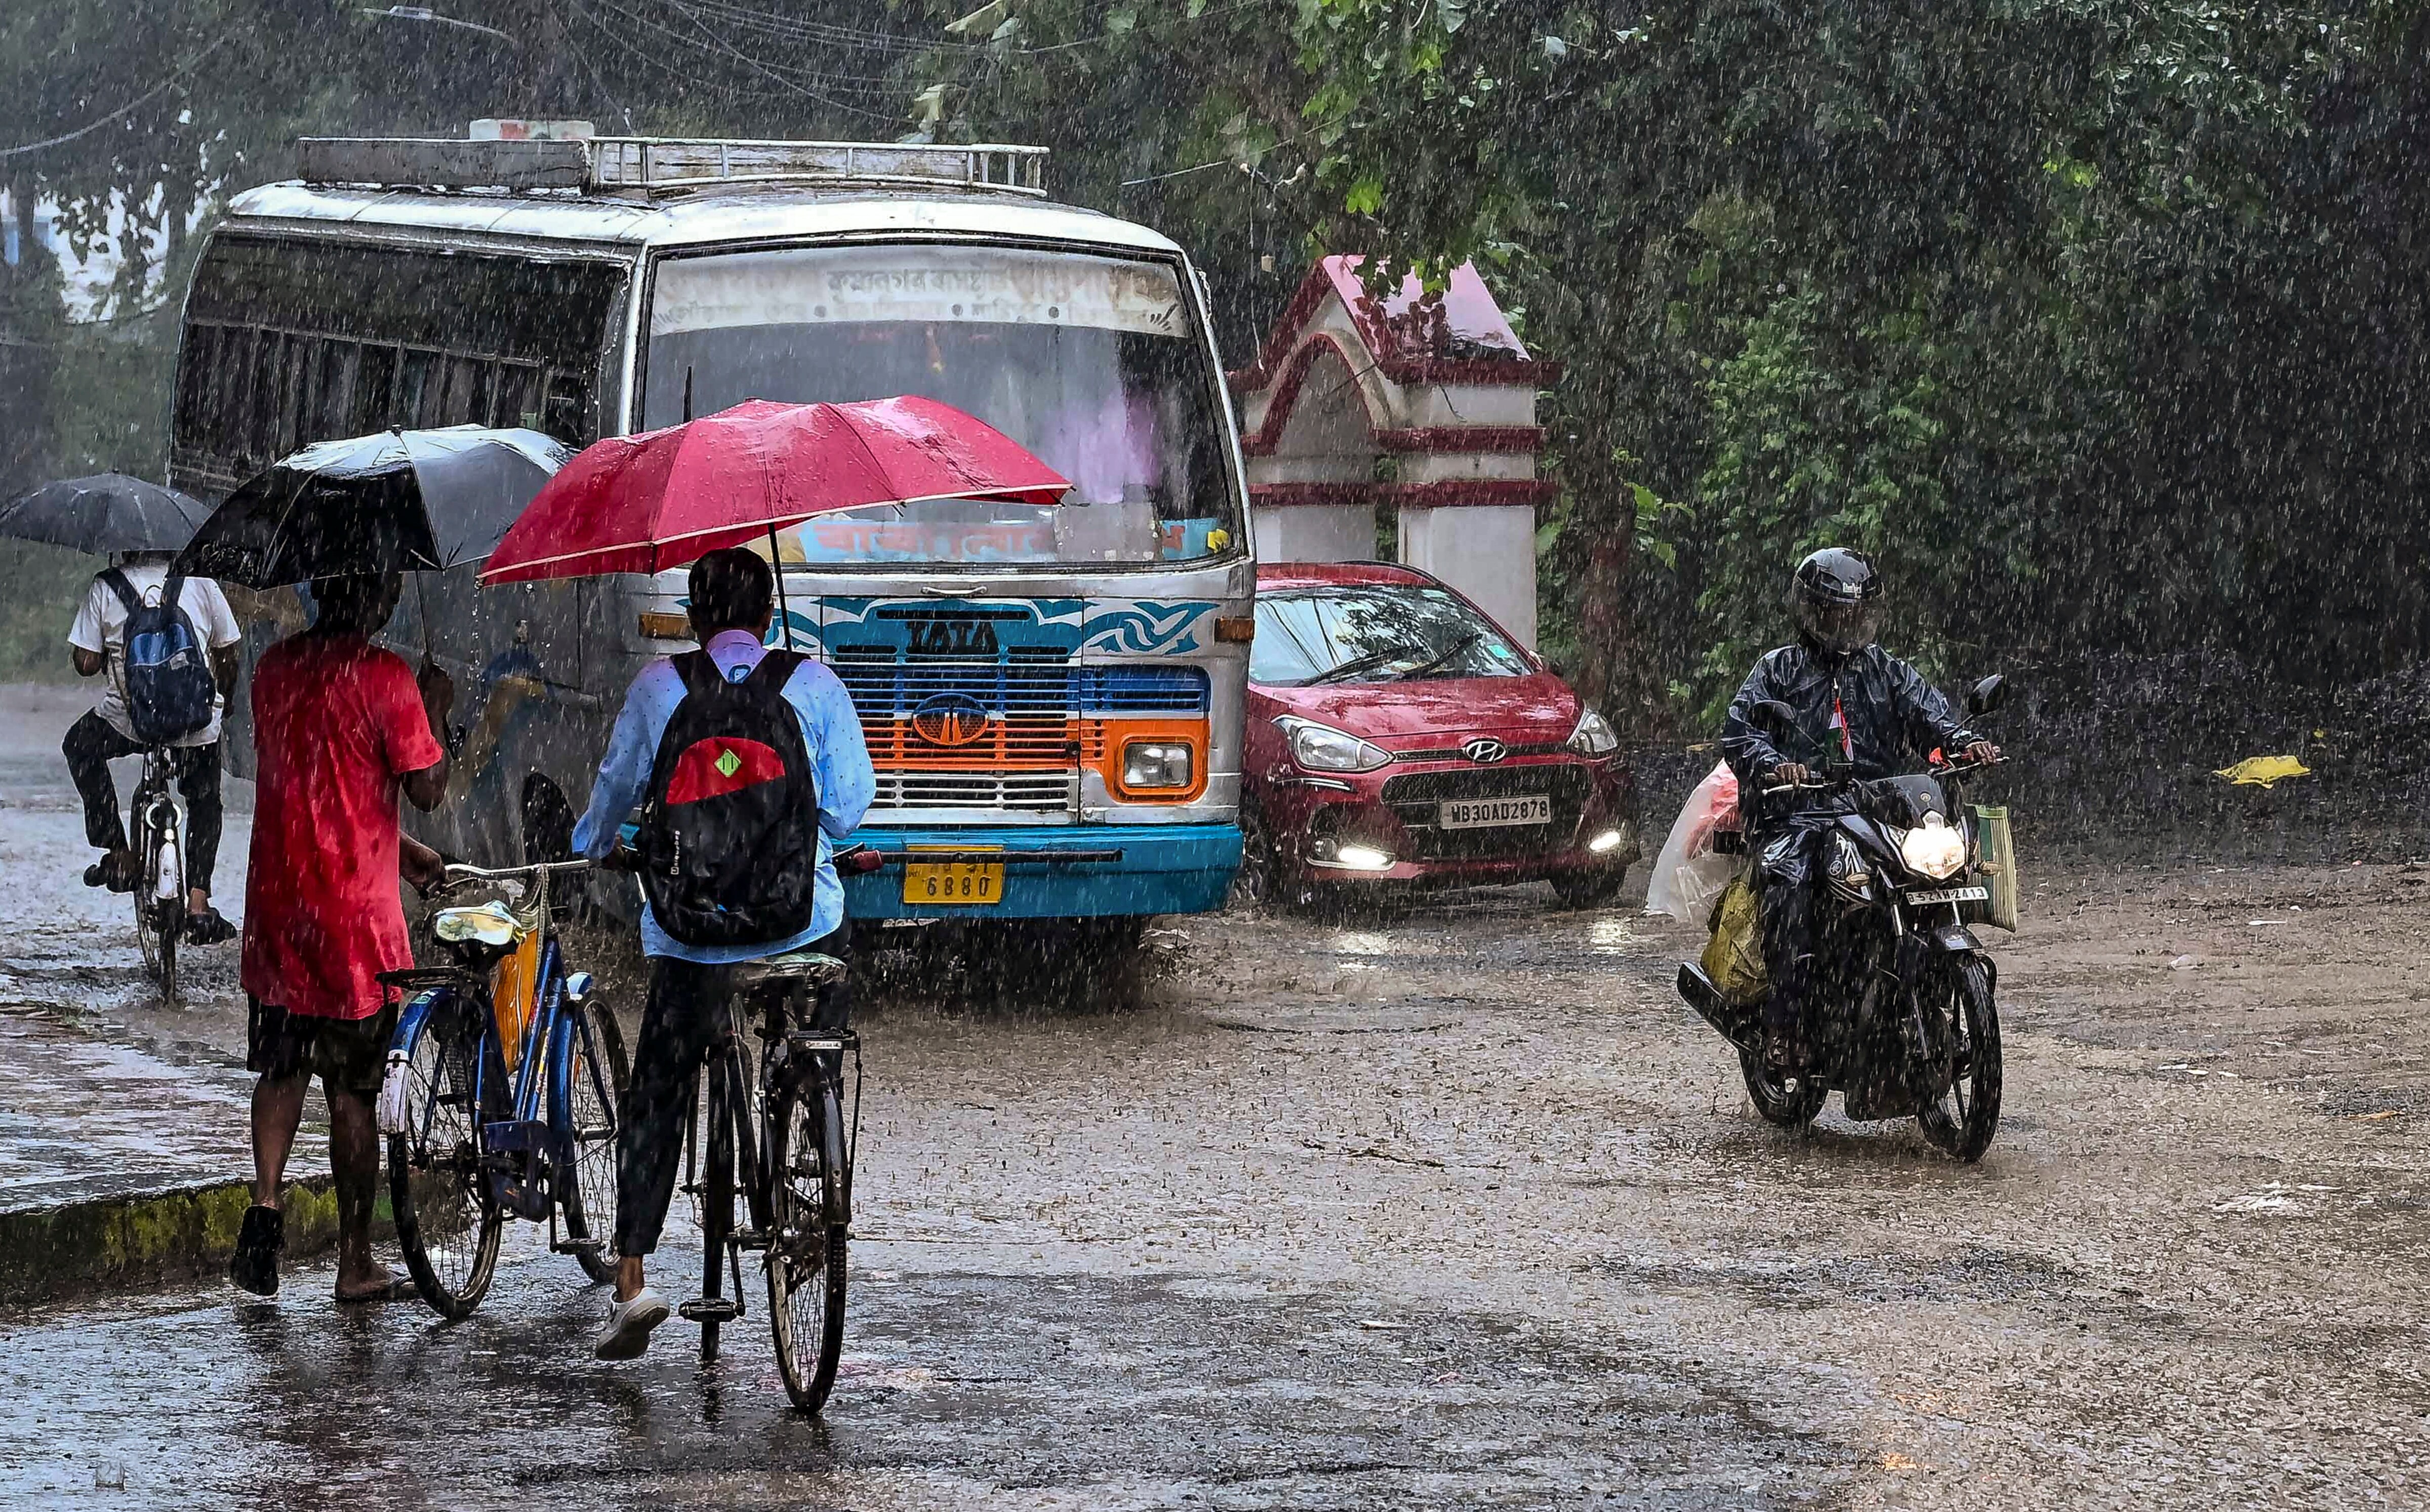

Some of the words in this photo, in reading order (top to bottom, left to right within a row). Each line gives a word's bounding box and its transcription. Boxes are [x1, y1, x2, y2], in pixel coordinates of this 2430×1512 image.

[906, 621, 999, 653] TATA
[1451, 800, 1548, 823] WB30AD2878
[927, 876, 989, 896] 6880
